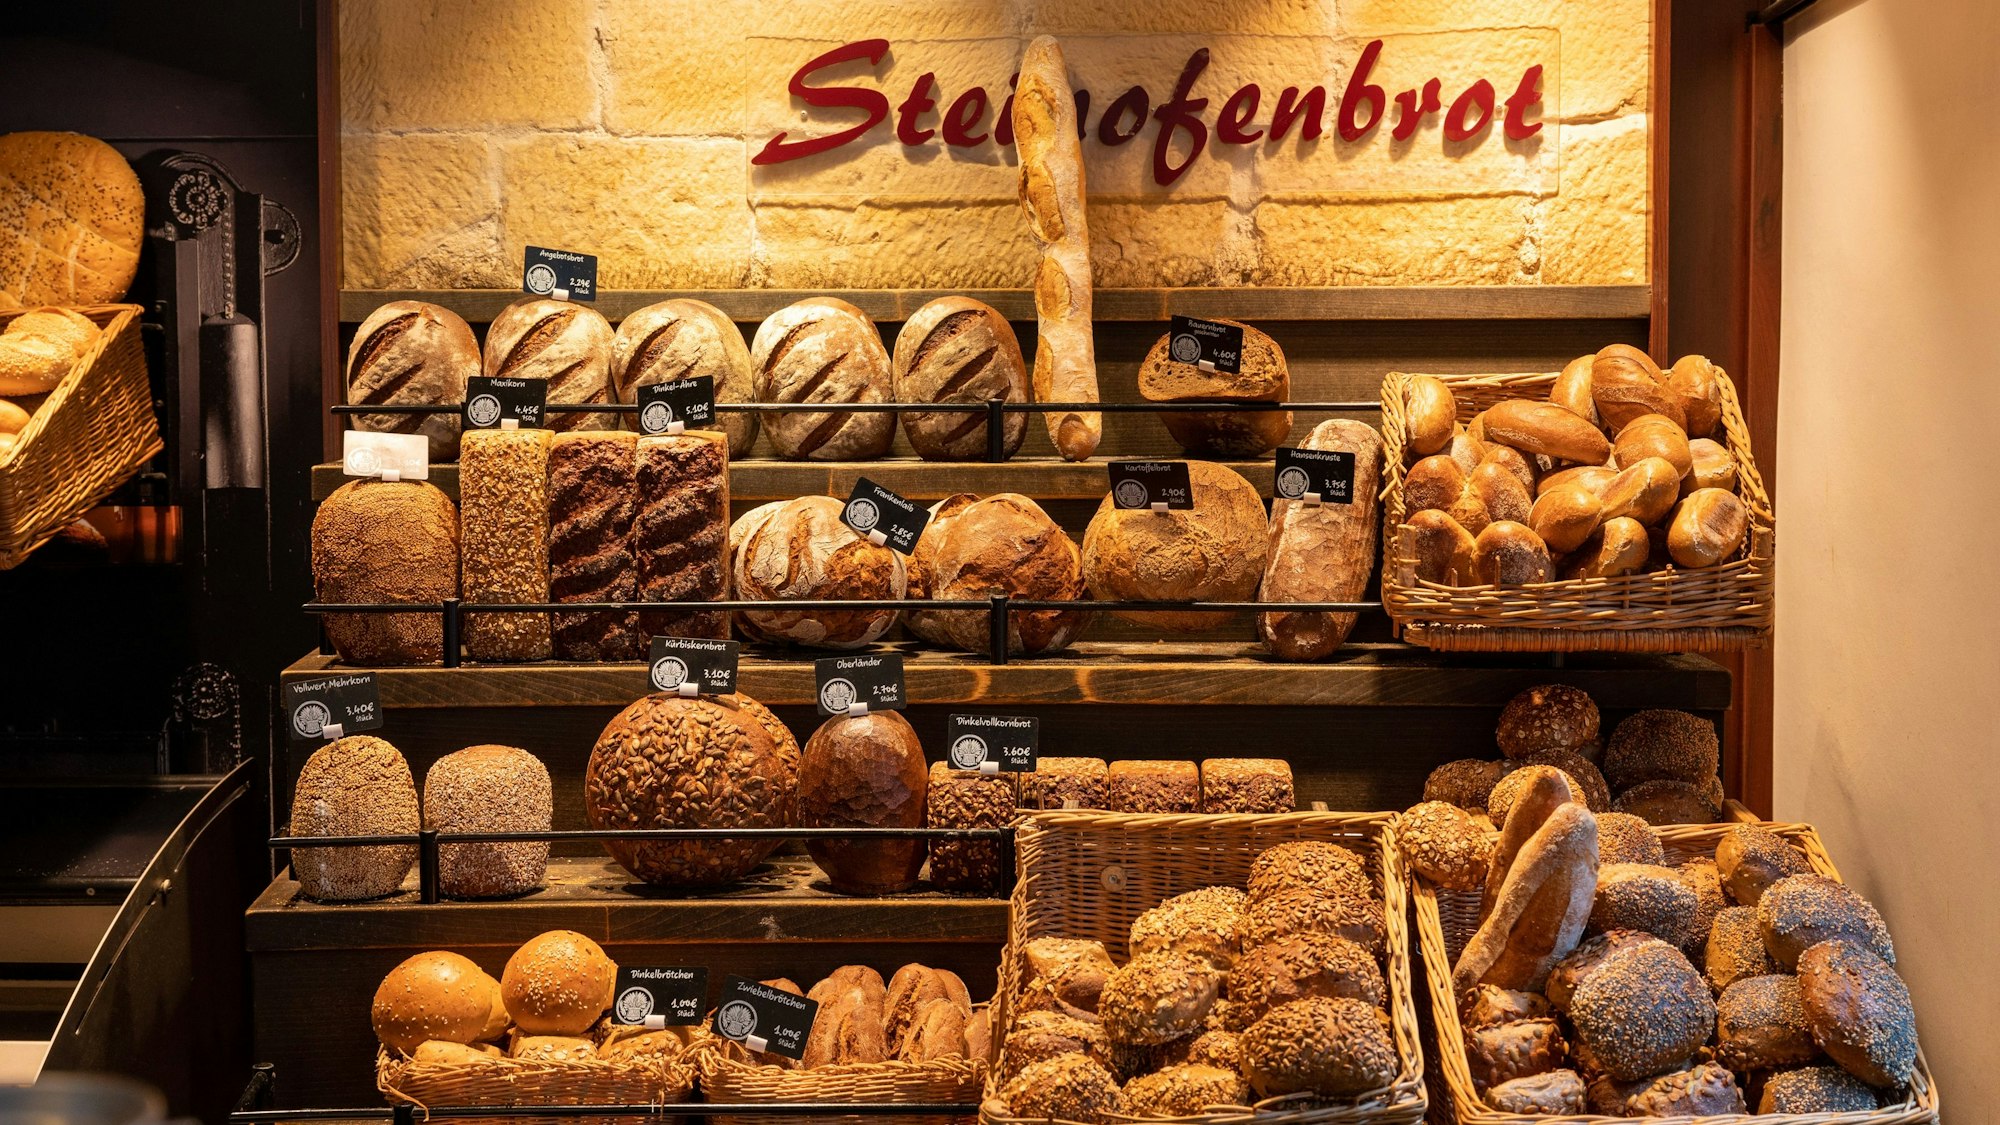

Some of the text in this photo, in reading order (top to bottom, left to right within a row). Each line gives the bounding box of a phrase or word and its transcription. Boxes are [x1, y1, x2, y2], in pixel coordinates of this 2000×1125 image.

[752, 39, 1543, 187] Steiofenbrot
[540, 249, 584, 262] Angebotsbrot
[570, 277, 590, 288] 2.29€
[1188, 319, 1226, 334] Bauernbrot
[1213, 348, 1236, 360] 4.60€
[490, 378, 526, 388] Maxikorn
[652, 380, 698, 394] Dinkel-Ähre
[515, 405, 539, 415] 4.45€
[686, 402, 709, 415] 5.10€
[693, 412, 708, 420] Stück
[1290, 449, 1342, 462] Hansenkruste
[1125, 463, 1171, 473] Kartoffelbrot
[1325, 479, 1347, 489] 3.75€
[1161, 488, 1185, 497] 2.90€
[1330, 489, 1346, 497] Stück
[873, 486, 914, 513] Frankenlaib
[890, 524, 914, 540] 2.85€
[893, 535, 909, 547] Stück
[665, 639, 726, 651] Kürbiskernbrot
[837, 656, 882, 669] Oberländer
[703, 668, 731, 679] 3.10€
[293, 676, 371, 694] Vollwert Mehrkorn
[710, 679, 729, 687] Stück
[872, 683, 898, 695] 2.70€
[880, 694, 898, 702] Stück
[345, 702, 374, 716] 3.40€
[355, 713, 374, 722] Stück
[956, 716, 1032, 728] Dinkelvollkornbrot
[1002, 746, 1031, 757] 3.60€
[1010, 756, 1029, 765] Stück
[630, 968, 694, 980] Dinkelbrötchen
[736, 981, 806, 1010] Zwiebelbrötchen
[670, 998, 698, 1009] 1.00€
[676, 1009, 696, 1018] Stück
[773, 1024, 802, 1041] 1.00€
[777, 1038, 797, 1050] Stück
